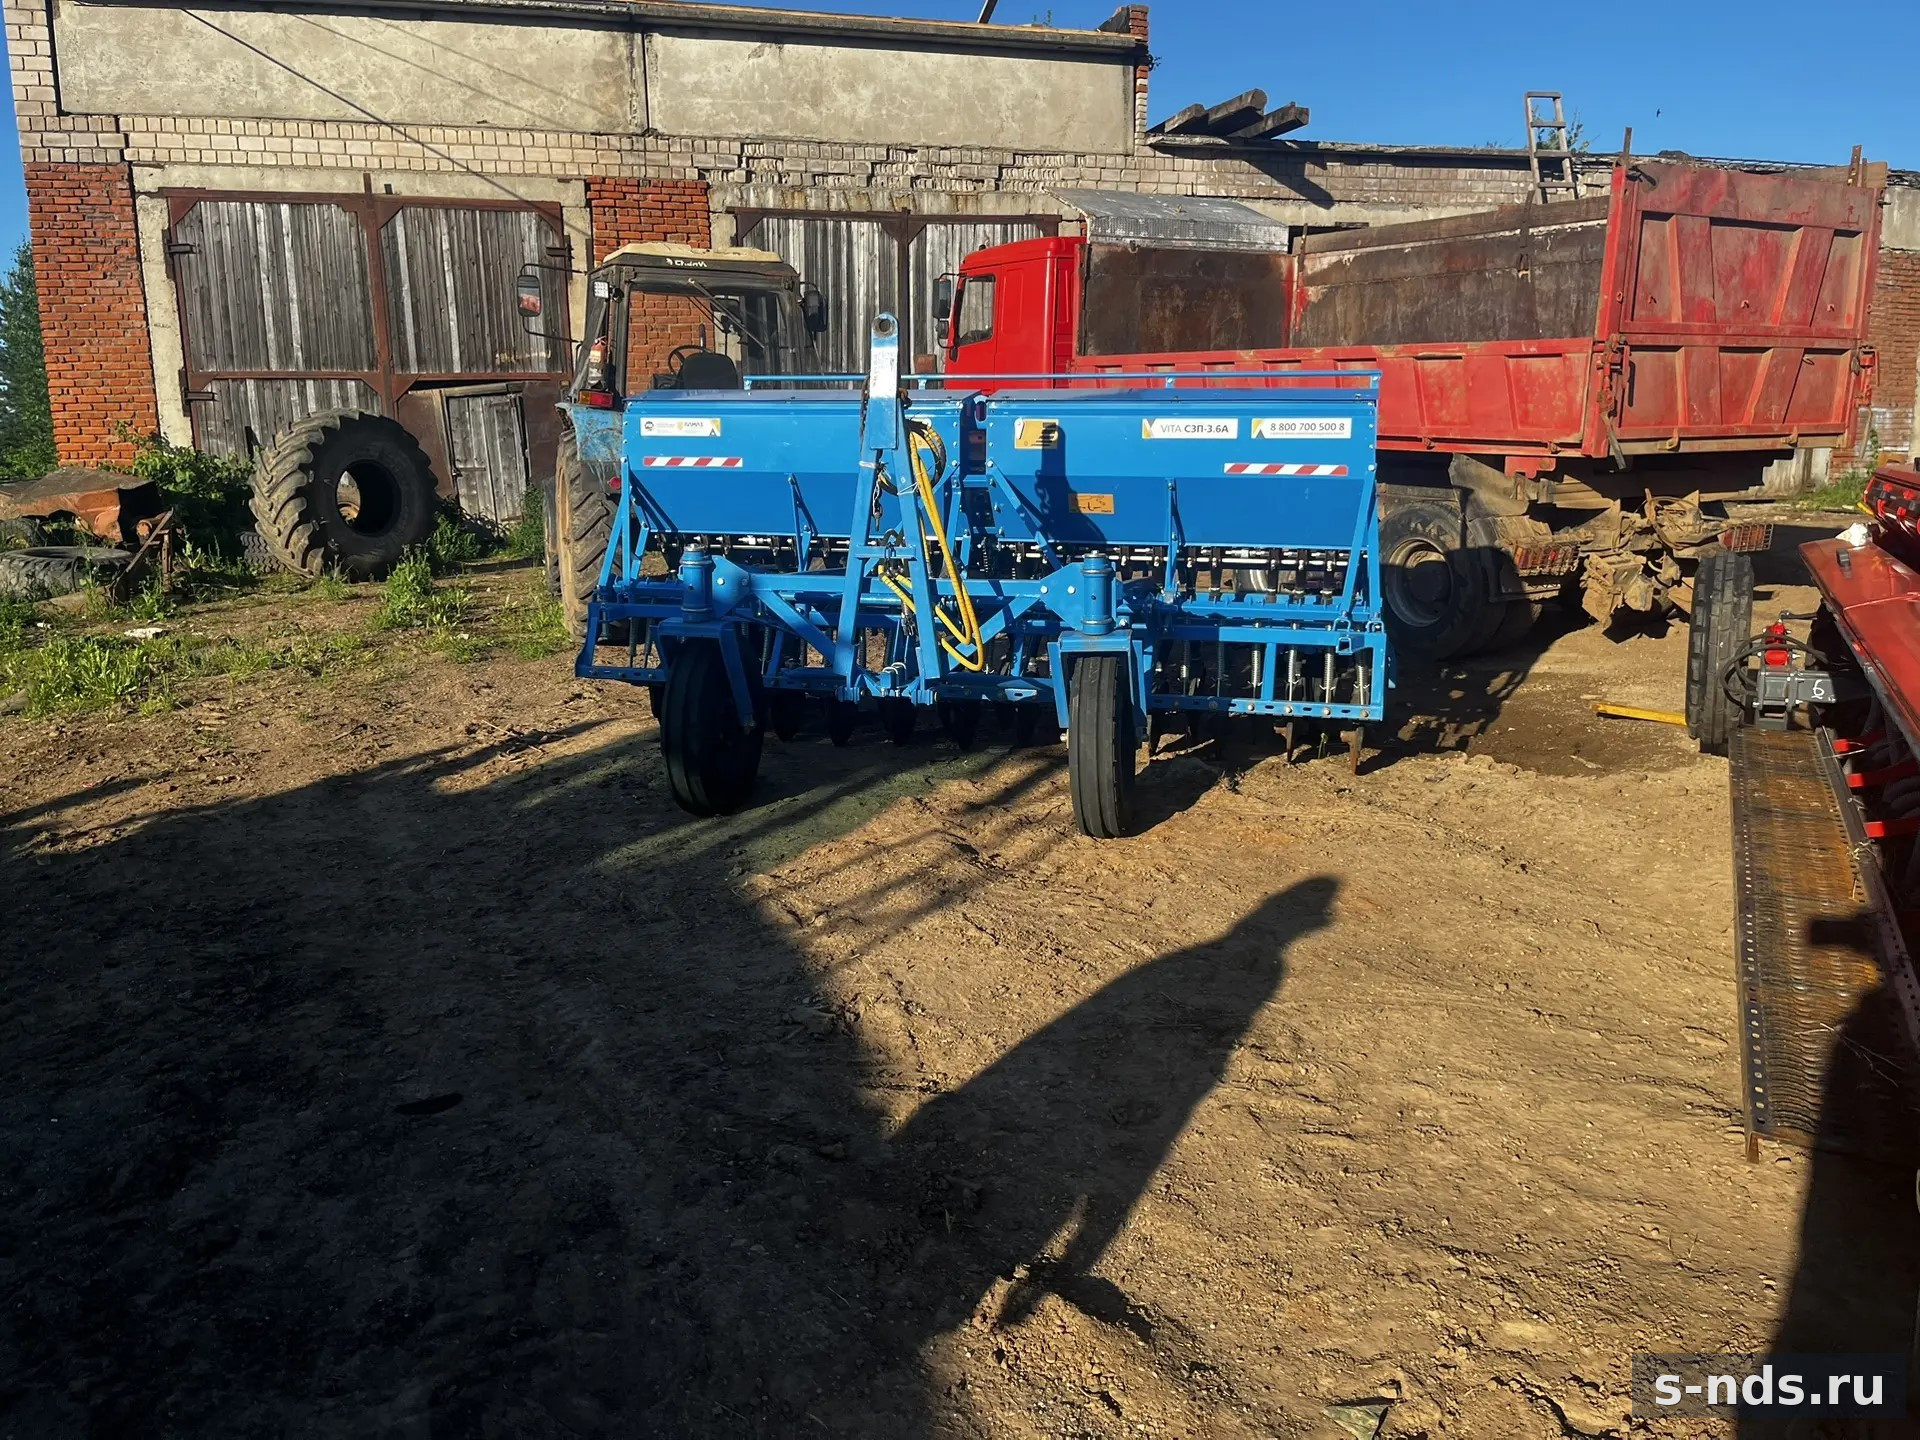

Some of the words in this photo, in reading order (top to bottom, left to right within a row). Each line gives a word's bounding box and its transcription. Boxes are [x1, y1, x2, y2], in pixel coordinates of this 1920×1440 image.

[1160, 424, 1182, 433] VITA
[1270, 422, 1276, 431] 8
[1278, 422, 1297, 431] 800
[1299, 422, 1317, 431] 700
[1319, 422, 1337, 431] 500
[1339, 422, 1345, 431] 8
